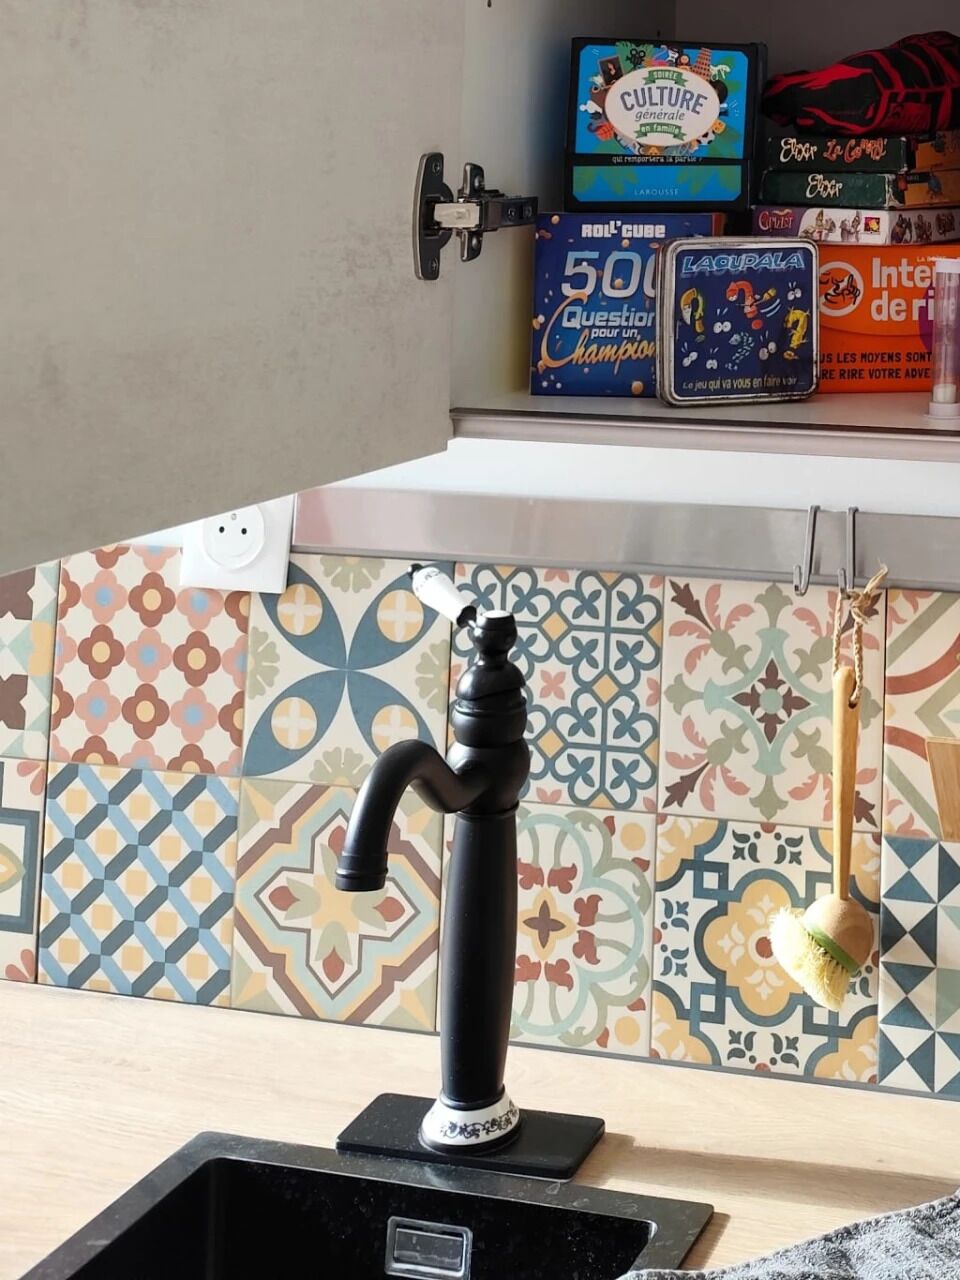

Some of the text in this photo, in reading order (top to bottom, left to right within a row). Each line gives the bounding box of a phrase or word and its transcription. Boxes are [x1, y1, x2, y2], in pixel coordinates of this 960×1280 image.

[620, 86, 708, 115] CULTURE
[635, 108, 686, 122] générale
[653, 124, 681, 134] famille
[779, 137, 818, 163] Elixir
[611, 156, 623, 164] qui
[634, 188, 679, 196] LAROUSSE
[805, 173, 843, 198] Elixir
[870, 290, 908, 322] de
[590, 328, 620, 340] pour
[836, 352, 857, 363] LES
[860, 351, 902, 363] MOYENS
[905, 351, 933, 362] SONT
[839, 368, 901, 381] RIRE VOTRE
[694, 380, 708, 392] jeu
[708, 377, 721, 392] qui
[722, 378, 732, 389] va
[733, 378, 752, 389] vous
[752, 379, 762, 388] en
[763, 375, 781, 388] faire
